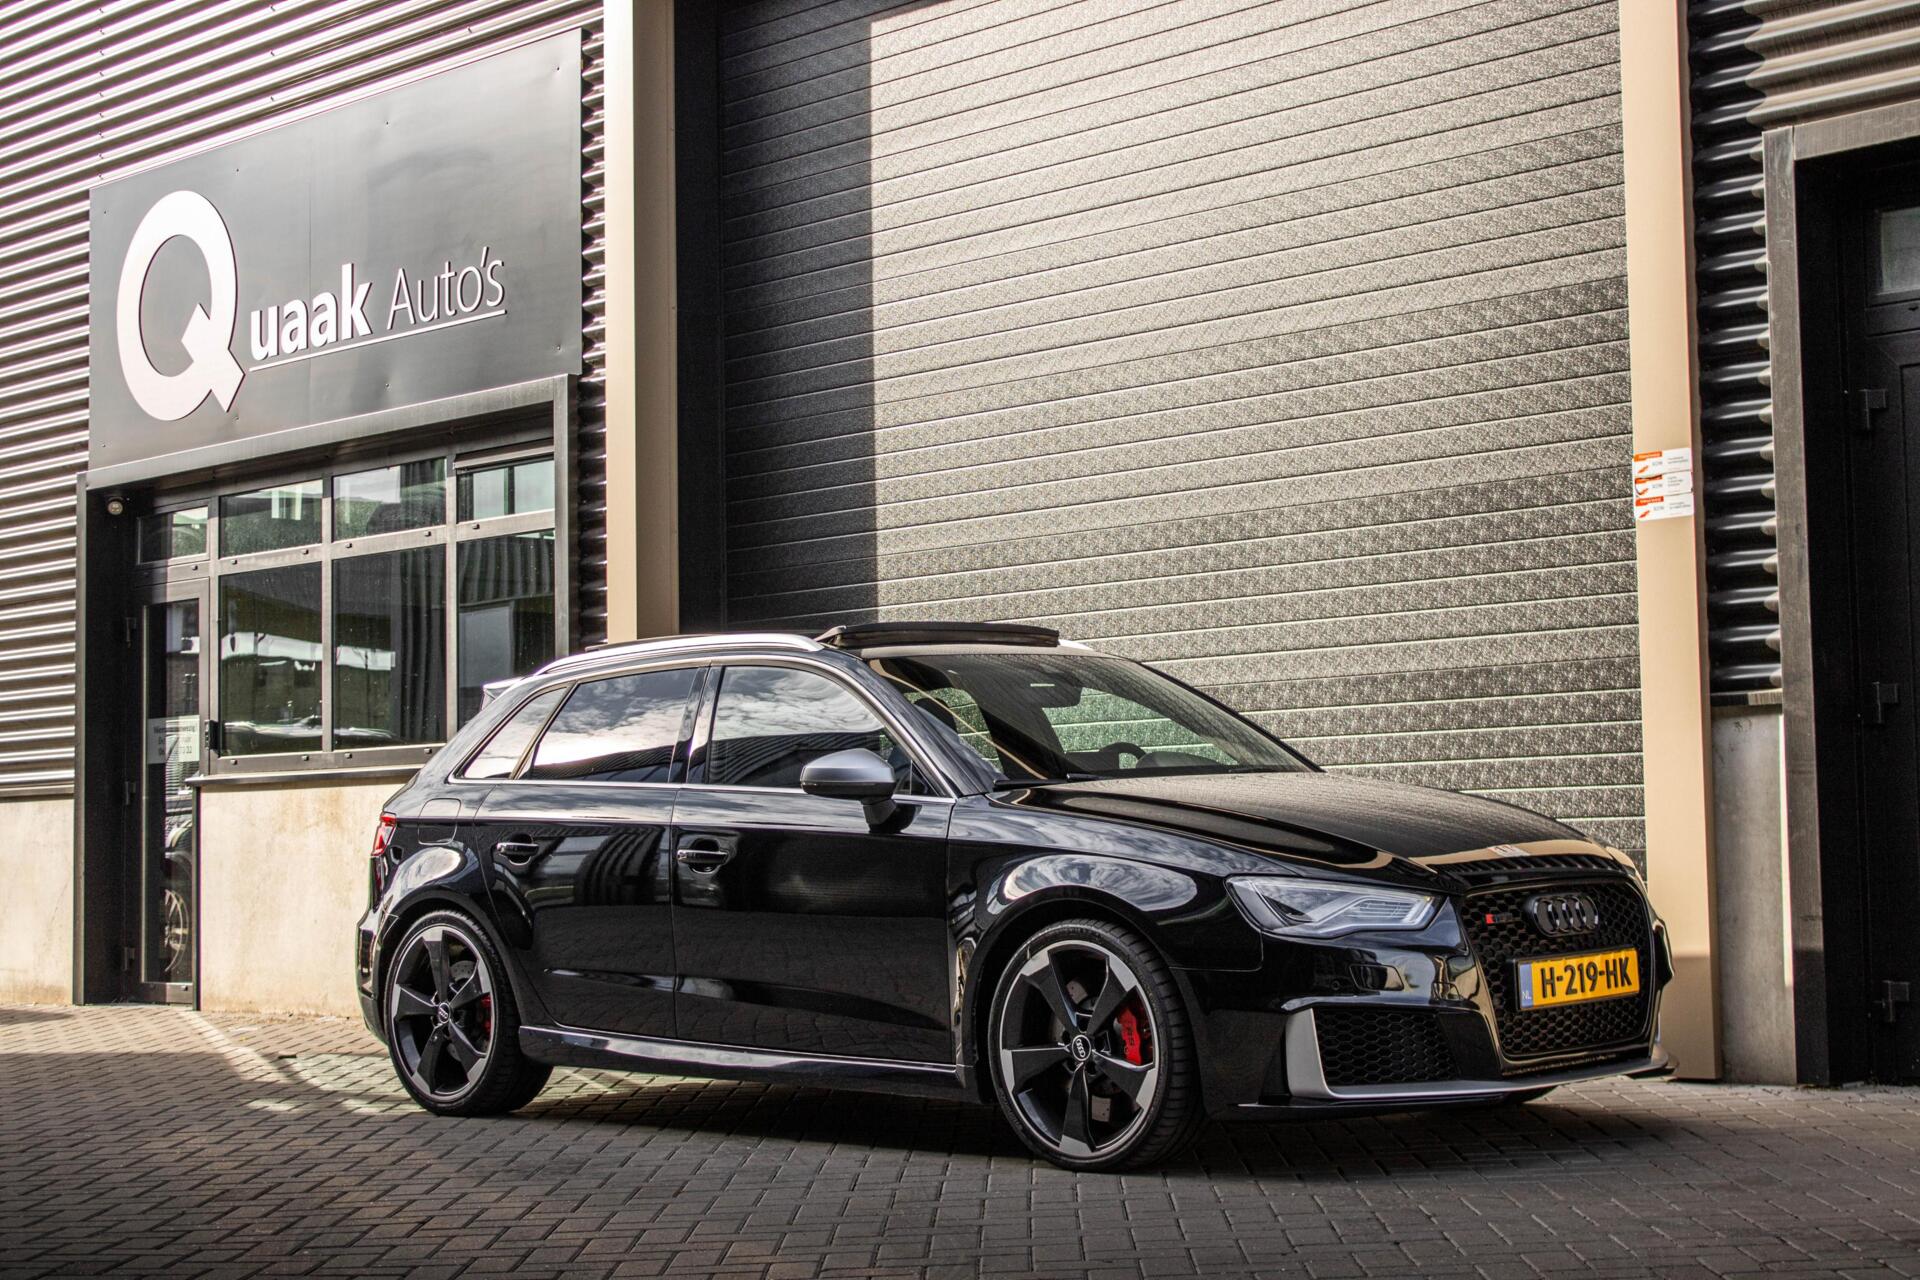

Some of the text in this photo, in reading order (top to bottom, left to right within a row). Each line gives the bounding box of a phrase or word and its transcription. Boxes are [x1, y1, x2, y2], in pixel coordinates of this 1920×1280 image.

[115, 190, 506, 421] Quaak Auto's
[1522, 956, 1632, 1000] NL H-219-HK
